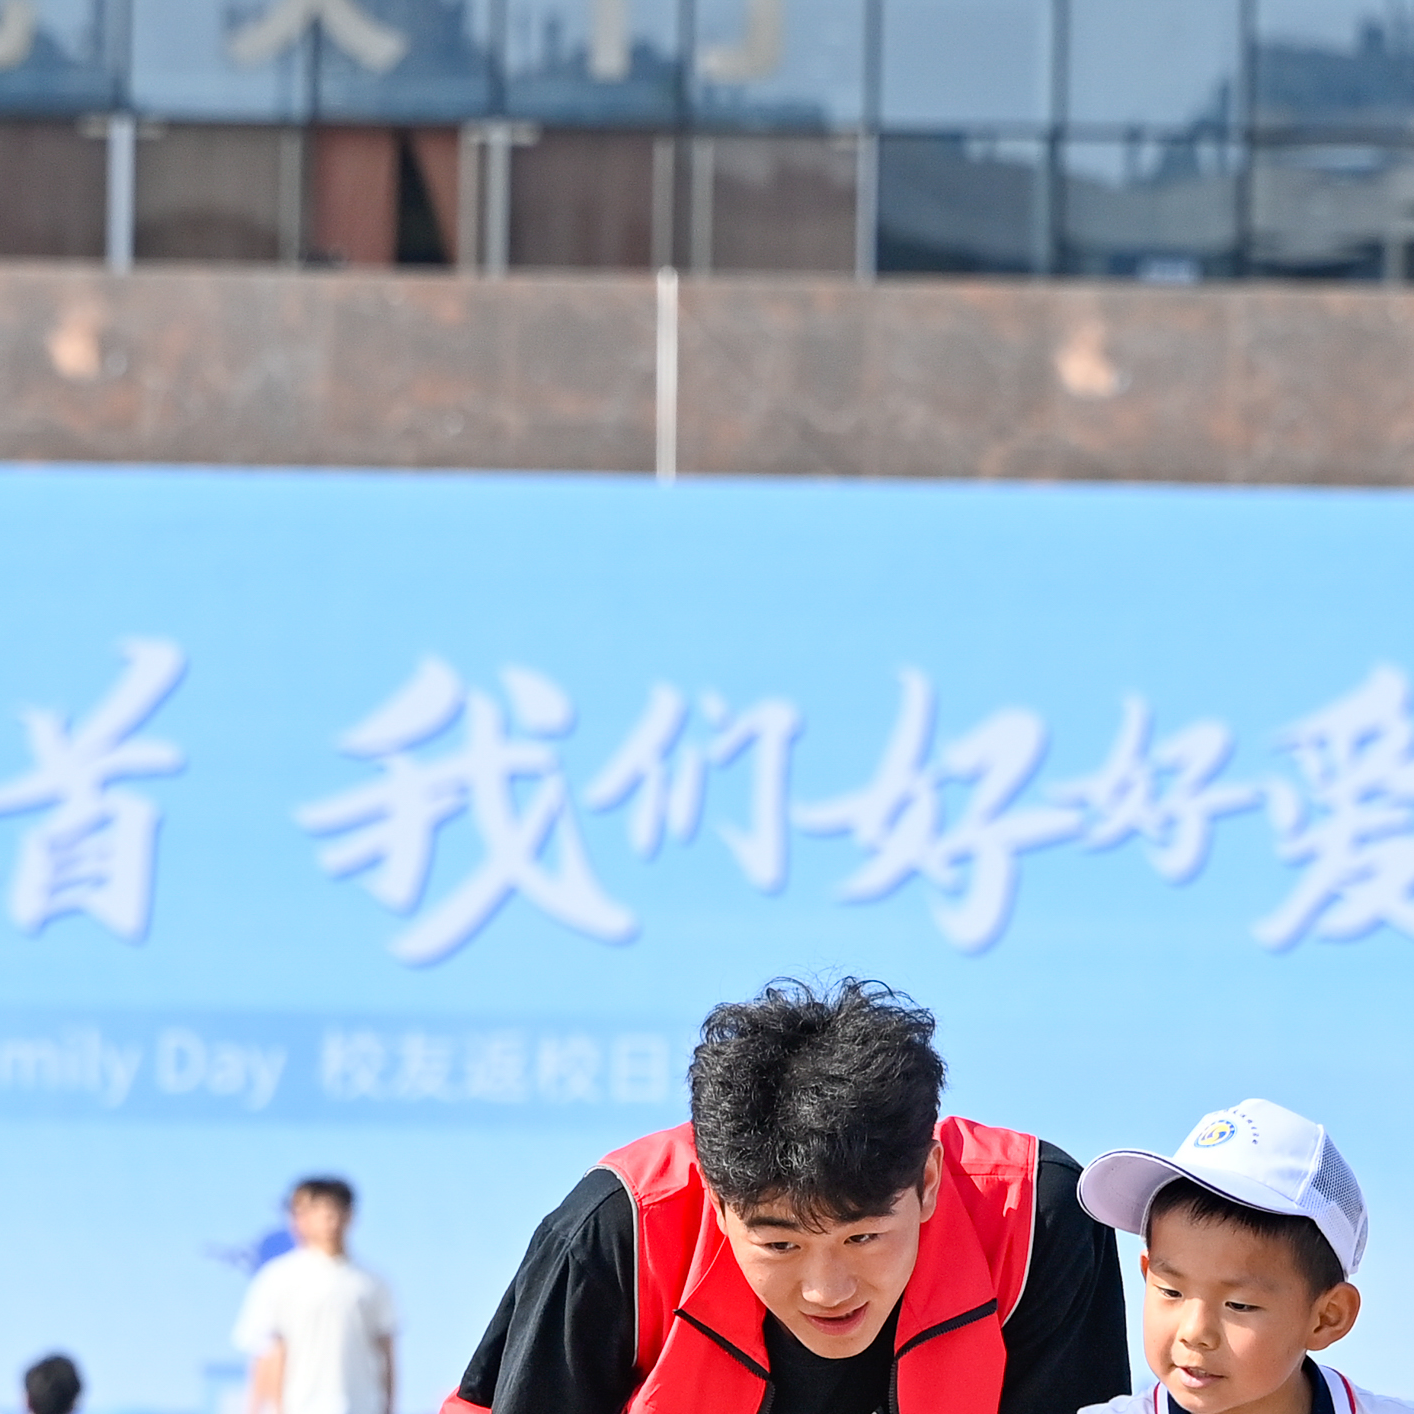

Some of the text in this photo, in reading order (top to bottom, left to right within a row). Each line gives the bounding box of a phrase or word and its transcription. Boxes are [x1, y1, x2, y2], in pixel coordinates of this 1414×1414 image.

[155, 1026, 287, 1110] Day
[319, 1024, 672, 1104] 校友返校日
